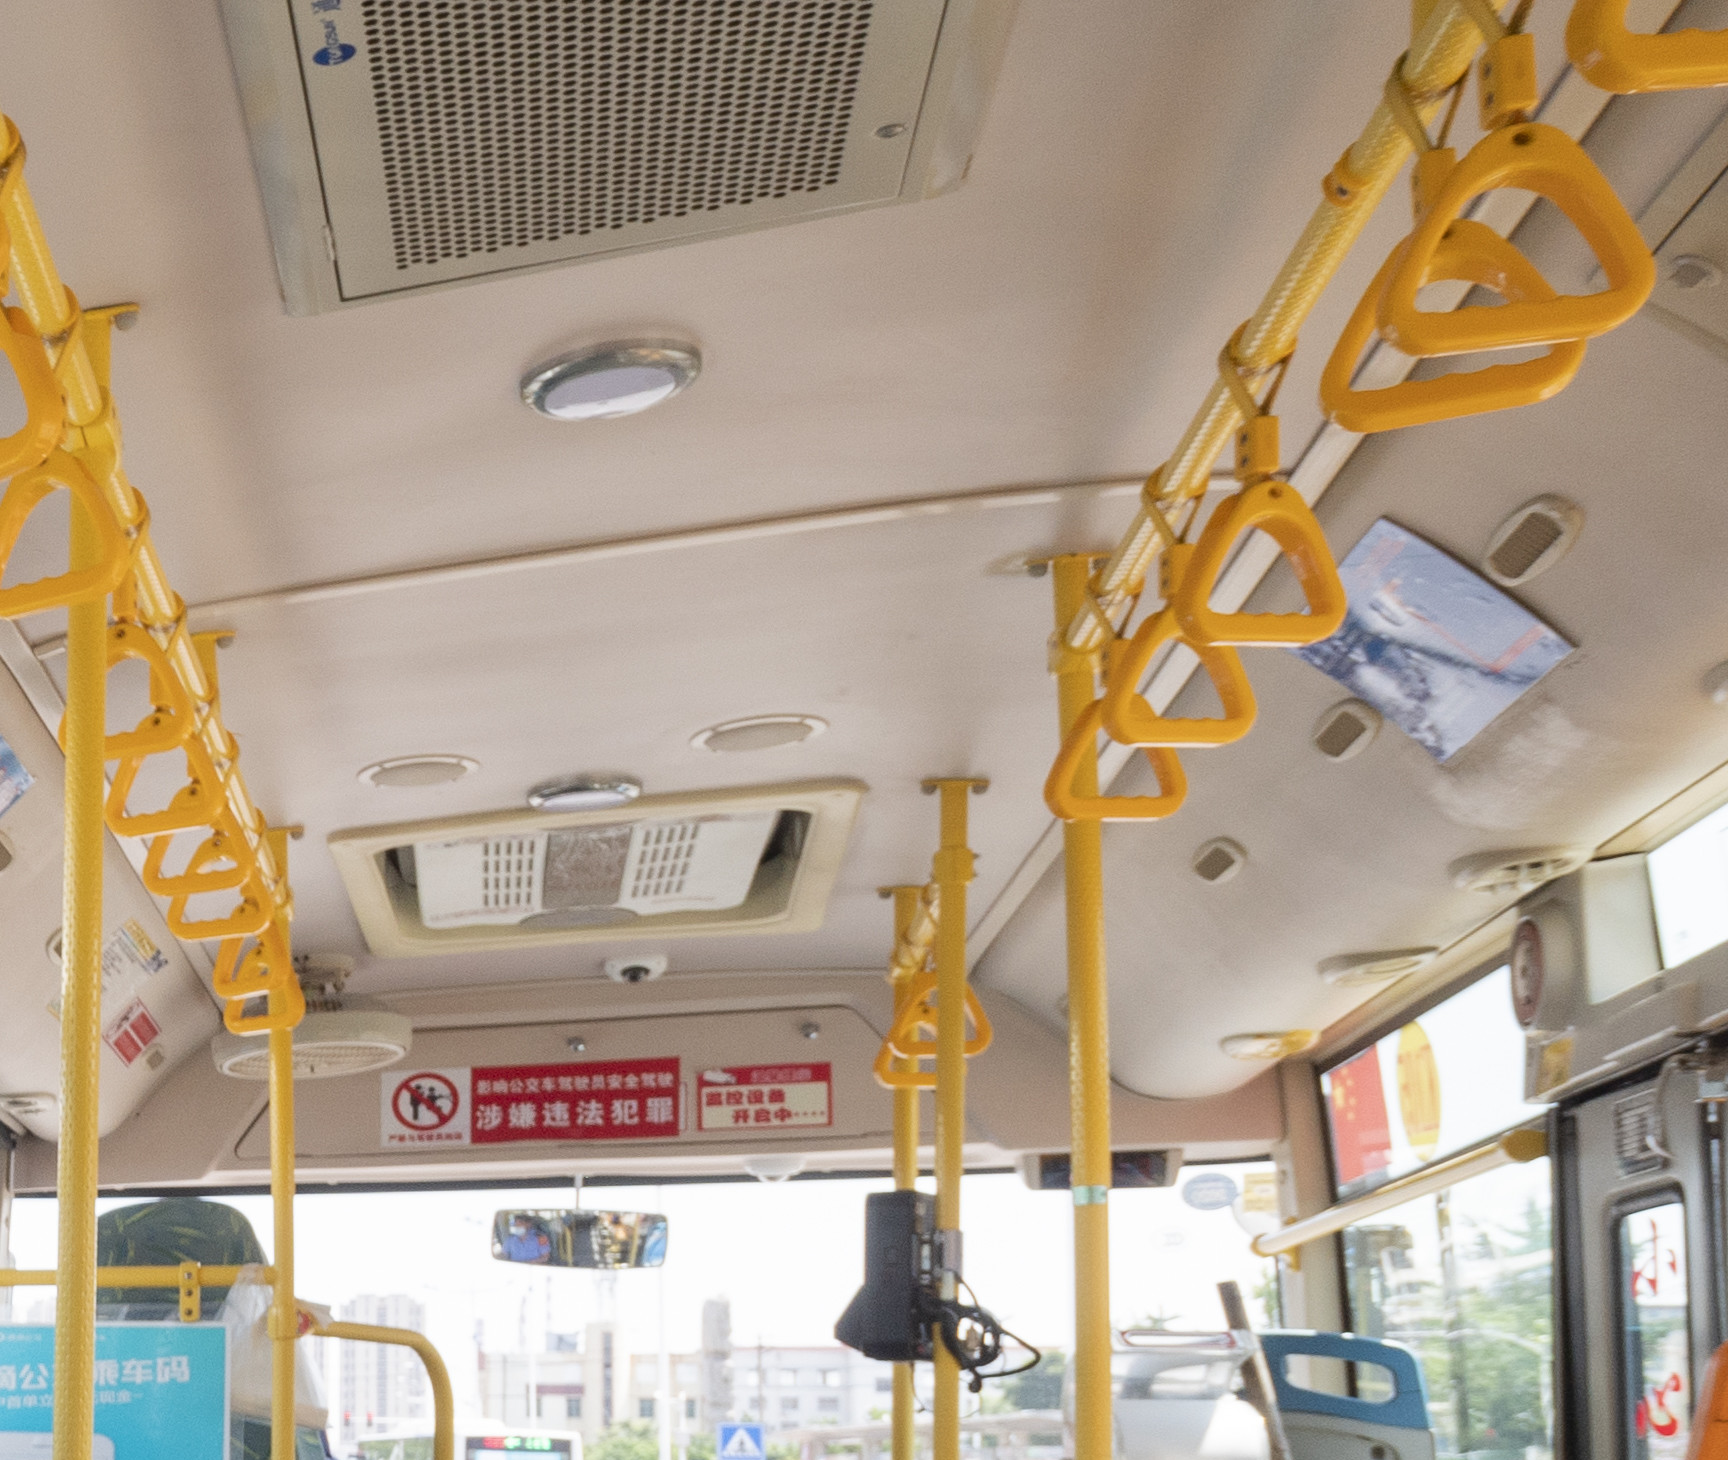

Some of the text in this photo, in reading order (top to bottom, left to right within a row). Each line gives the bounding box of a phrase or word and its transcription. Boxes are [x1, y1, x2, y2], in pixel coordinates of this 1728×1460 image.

[705, 1088, 786, 1107] 监控设备
[475, 1096, 675, 1131] 涉嫌违法犯罪
